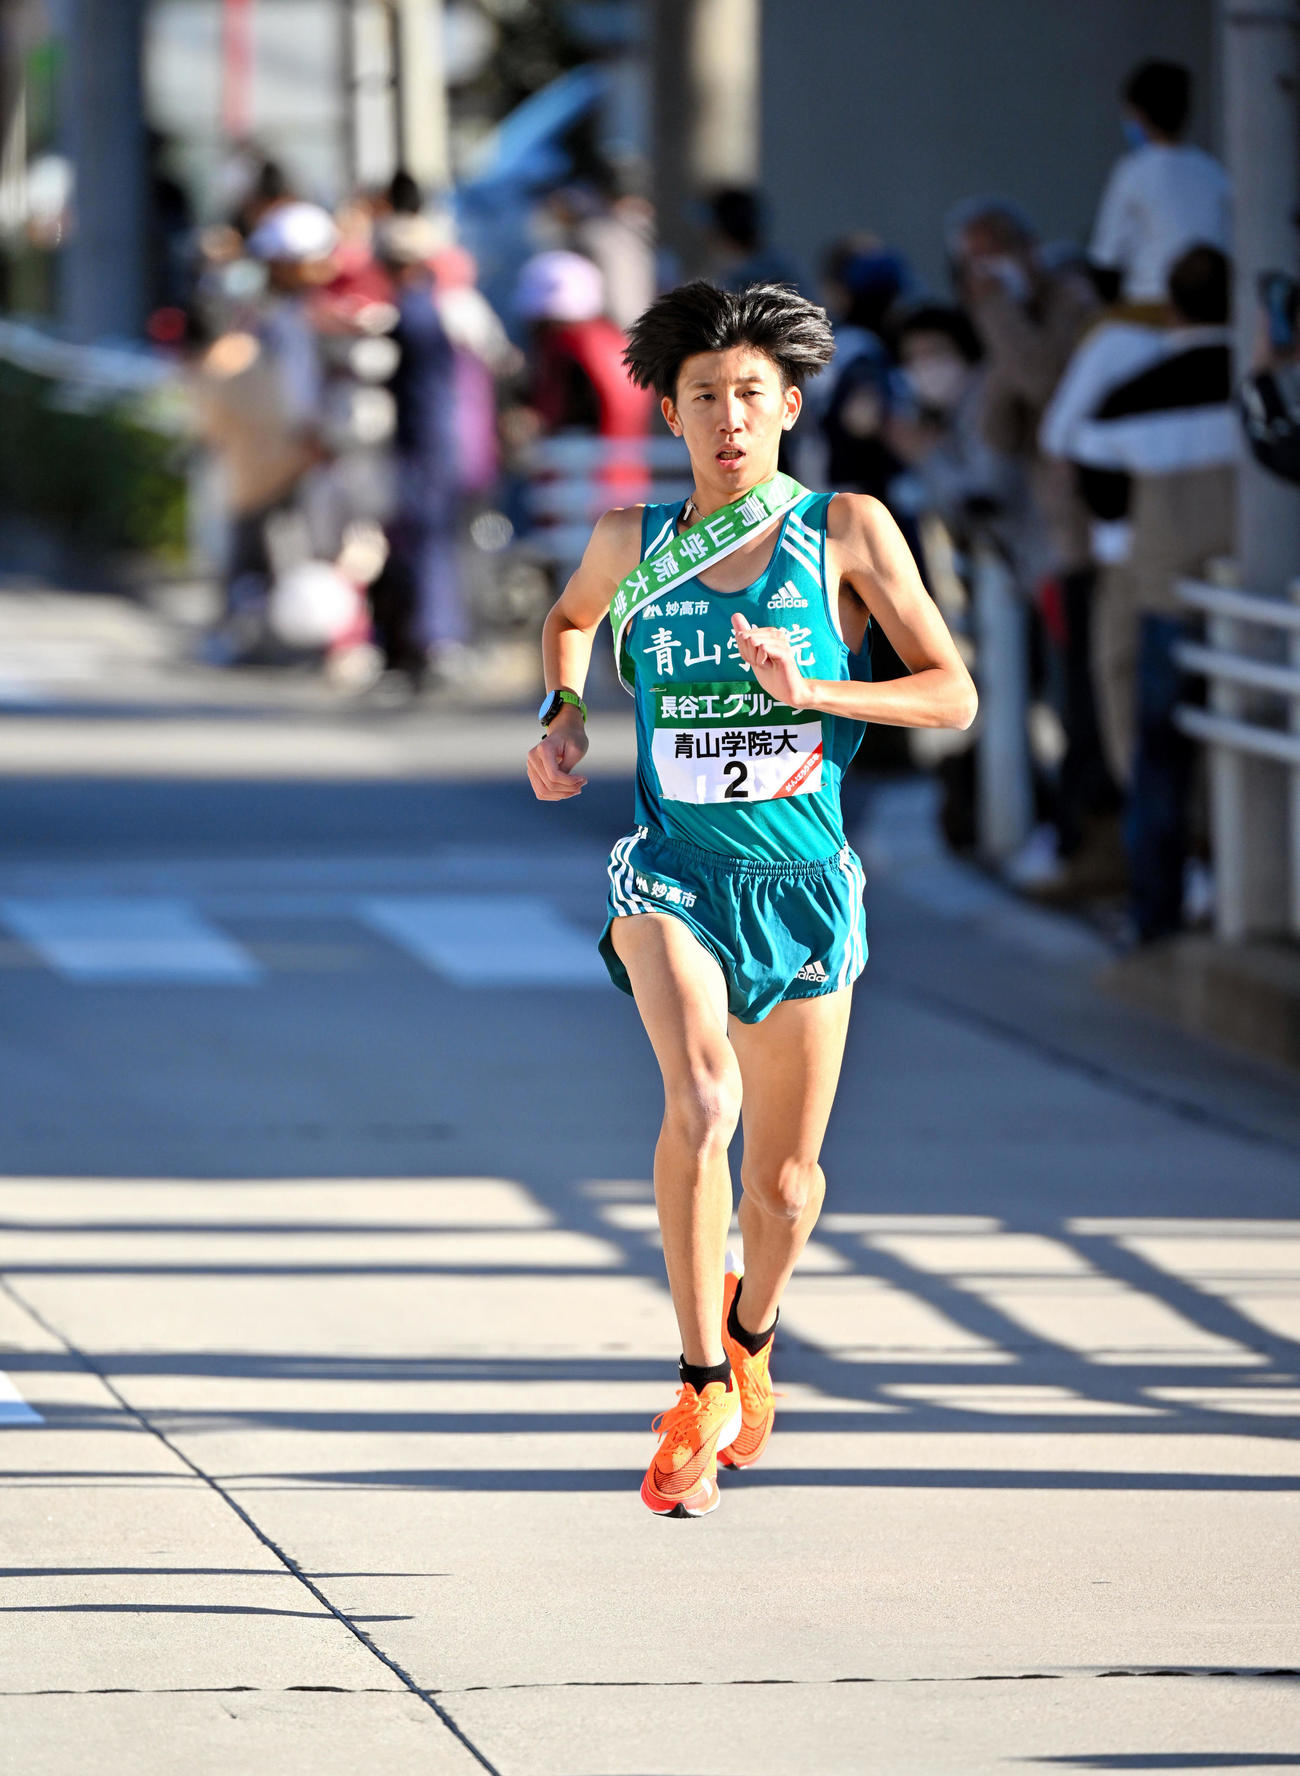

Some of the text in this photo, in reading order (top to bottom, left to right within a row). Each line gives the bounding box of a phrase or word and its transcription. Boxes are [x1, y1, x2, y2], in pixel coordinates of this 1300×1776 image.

[613, 494, 769, 619] 青山学院大学
[665, 600, 710, 617] 妙高市
[767, 596, 809, 609] adidas
[660, 693, 804, 719] 長谷工グルー
[674, 729, 799, 759] 青山学院大
[722, 760, 749, 799] 2
[651, 883, 697, 908] 妙高市
